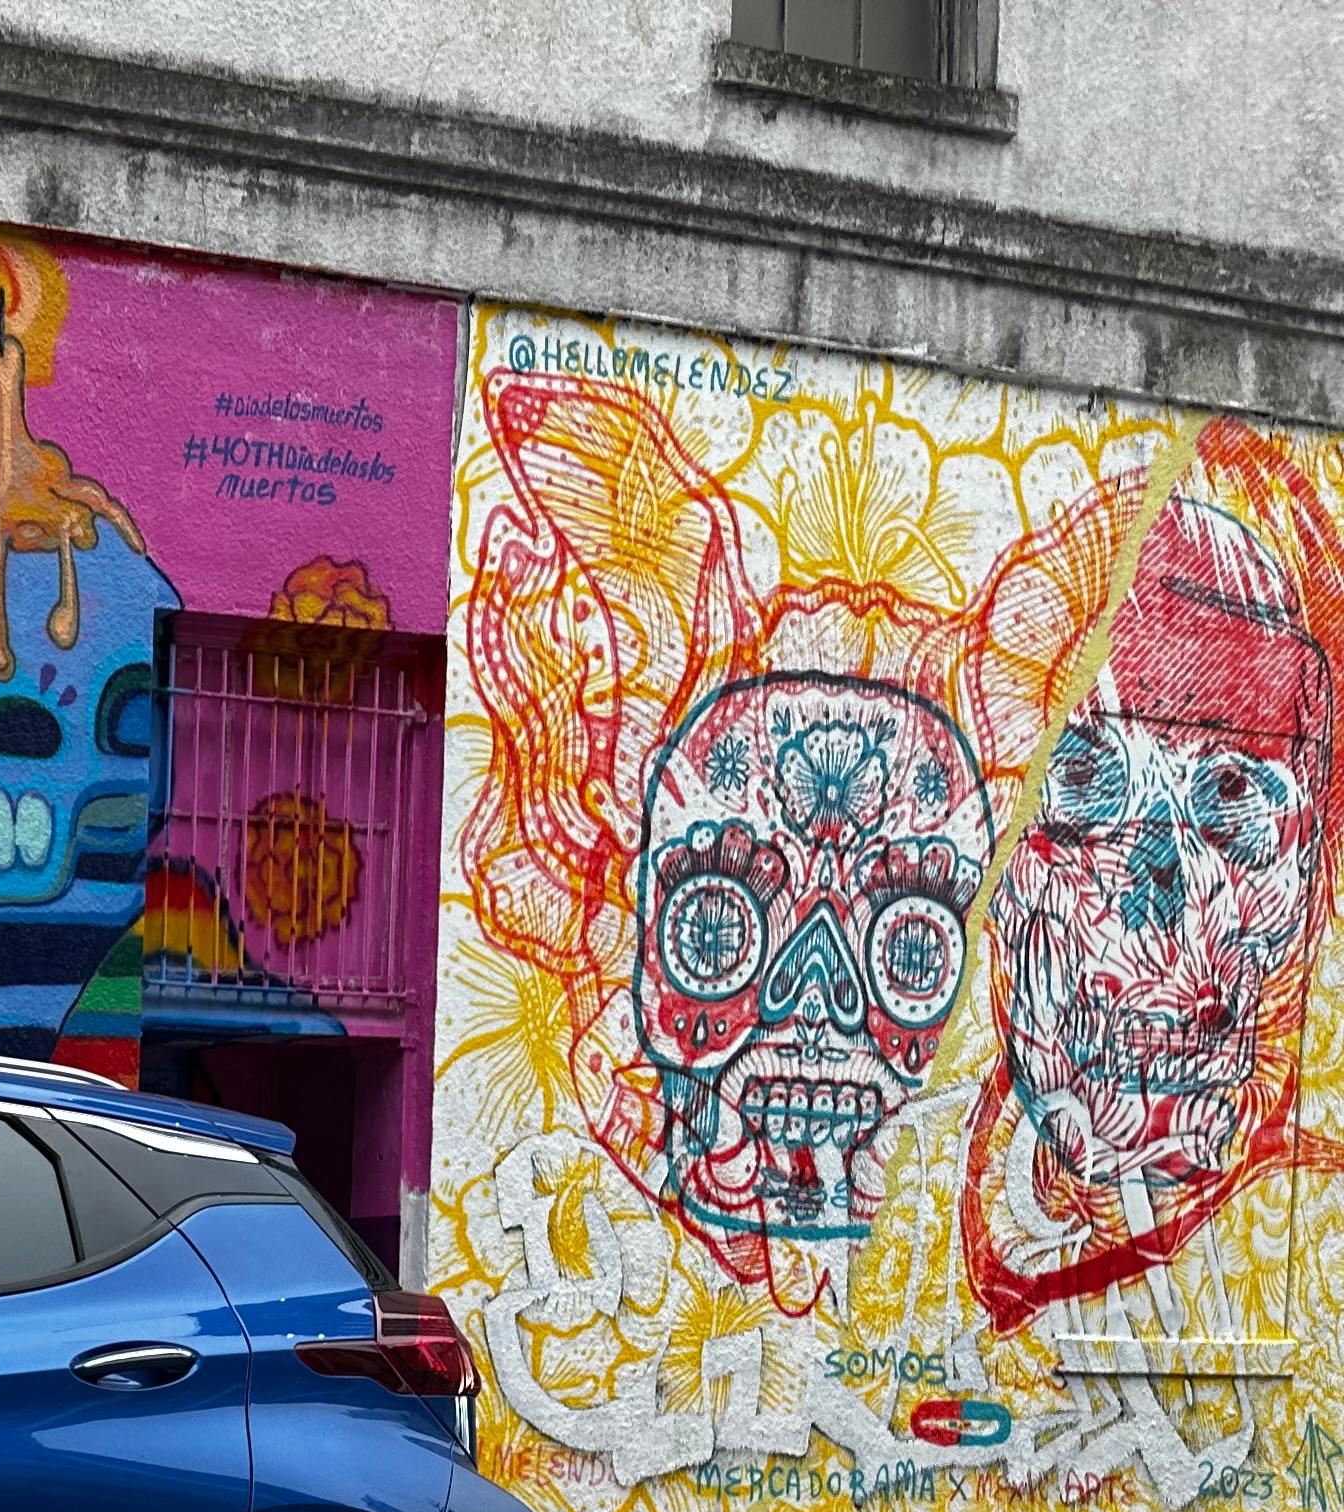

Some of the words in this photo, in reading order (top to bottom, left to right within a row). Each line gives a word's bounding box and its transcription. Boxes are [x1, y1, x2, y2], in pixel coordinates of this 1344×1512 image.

[509, 335, 793, 403] @HELLOMELENDEZ
[823, 1345, 949, 1385] SOMOS
[696, 1458, 935, 1502] MERCADORAMA
[1198, 1460, 1276, 1500] 2023
